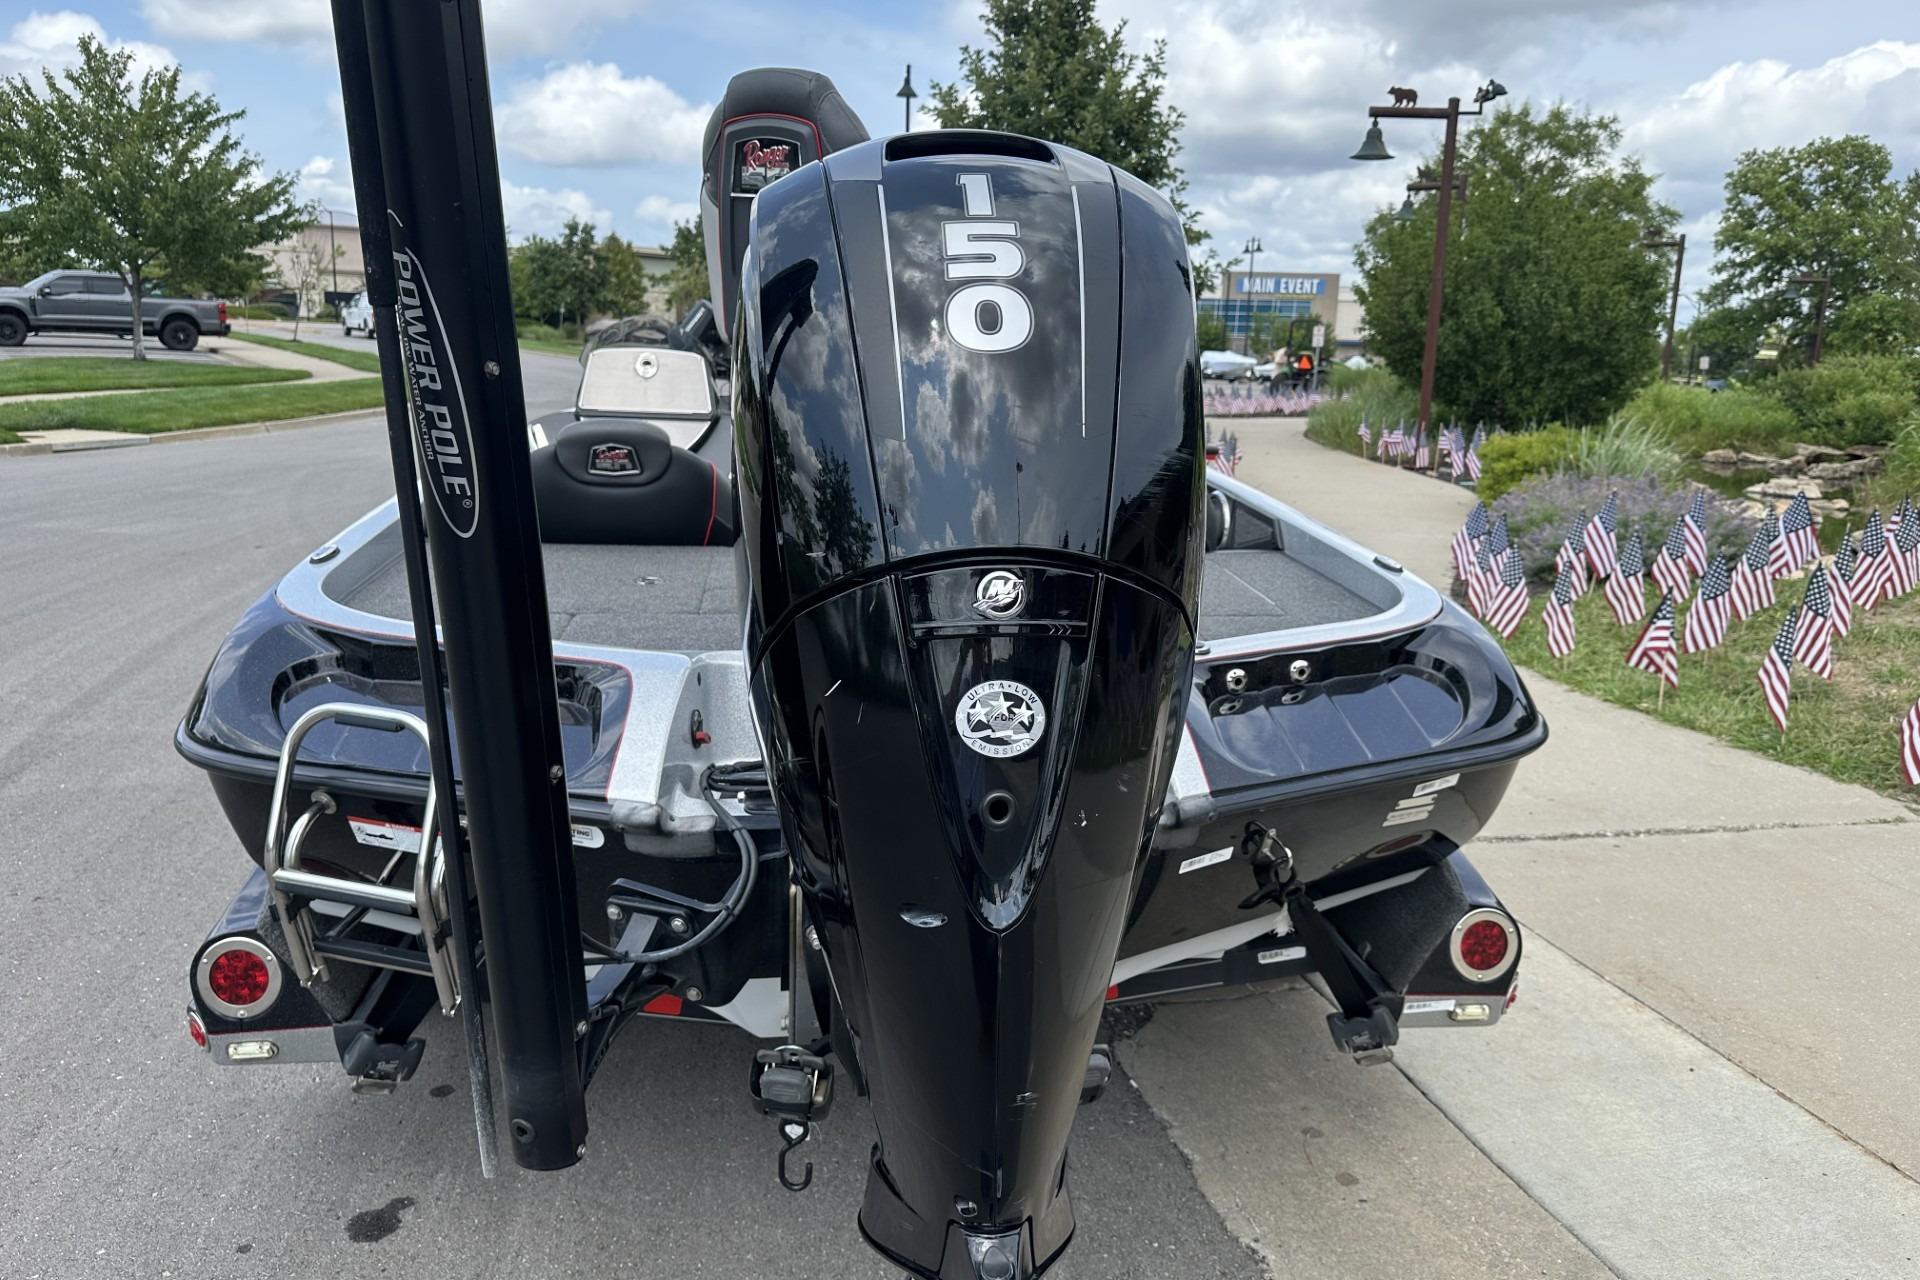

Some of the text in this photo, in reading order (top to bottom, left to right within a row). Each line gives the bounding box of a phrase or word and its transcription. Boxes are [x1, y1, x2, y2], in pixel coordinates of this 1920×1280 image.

[941, 172, 1035, 354] 150
[1242, 277, 1320, 294] MAIN EVENT
[392, 251, 471, 496] POWER POLE
[408, 361, 421, 405] WATER
[418, 409, 434, 460] ANCHOR
[967, 682, 1038, 704] ULTRA LOW
[971, 739, 1030, 755] EMISSION
